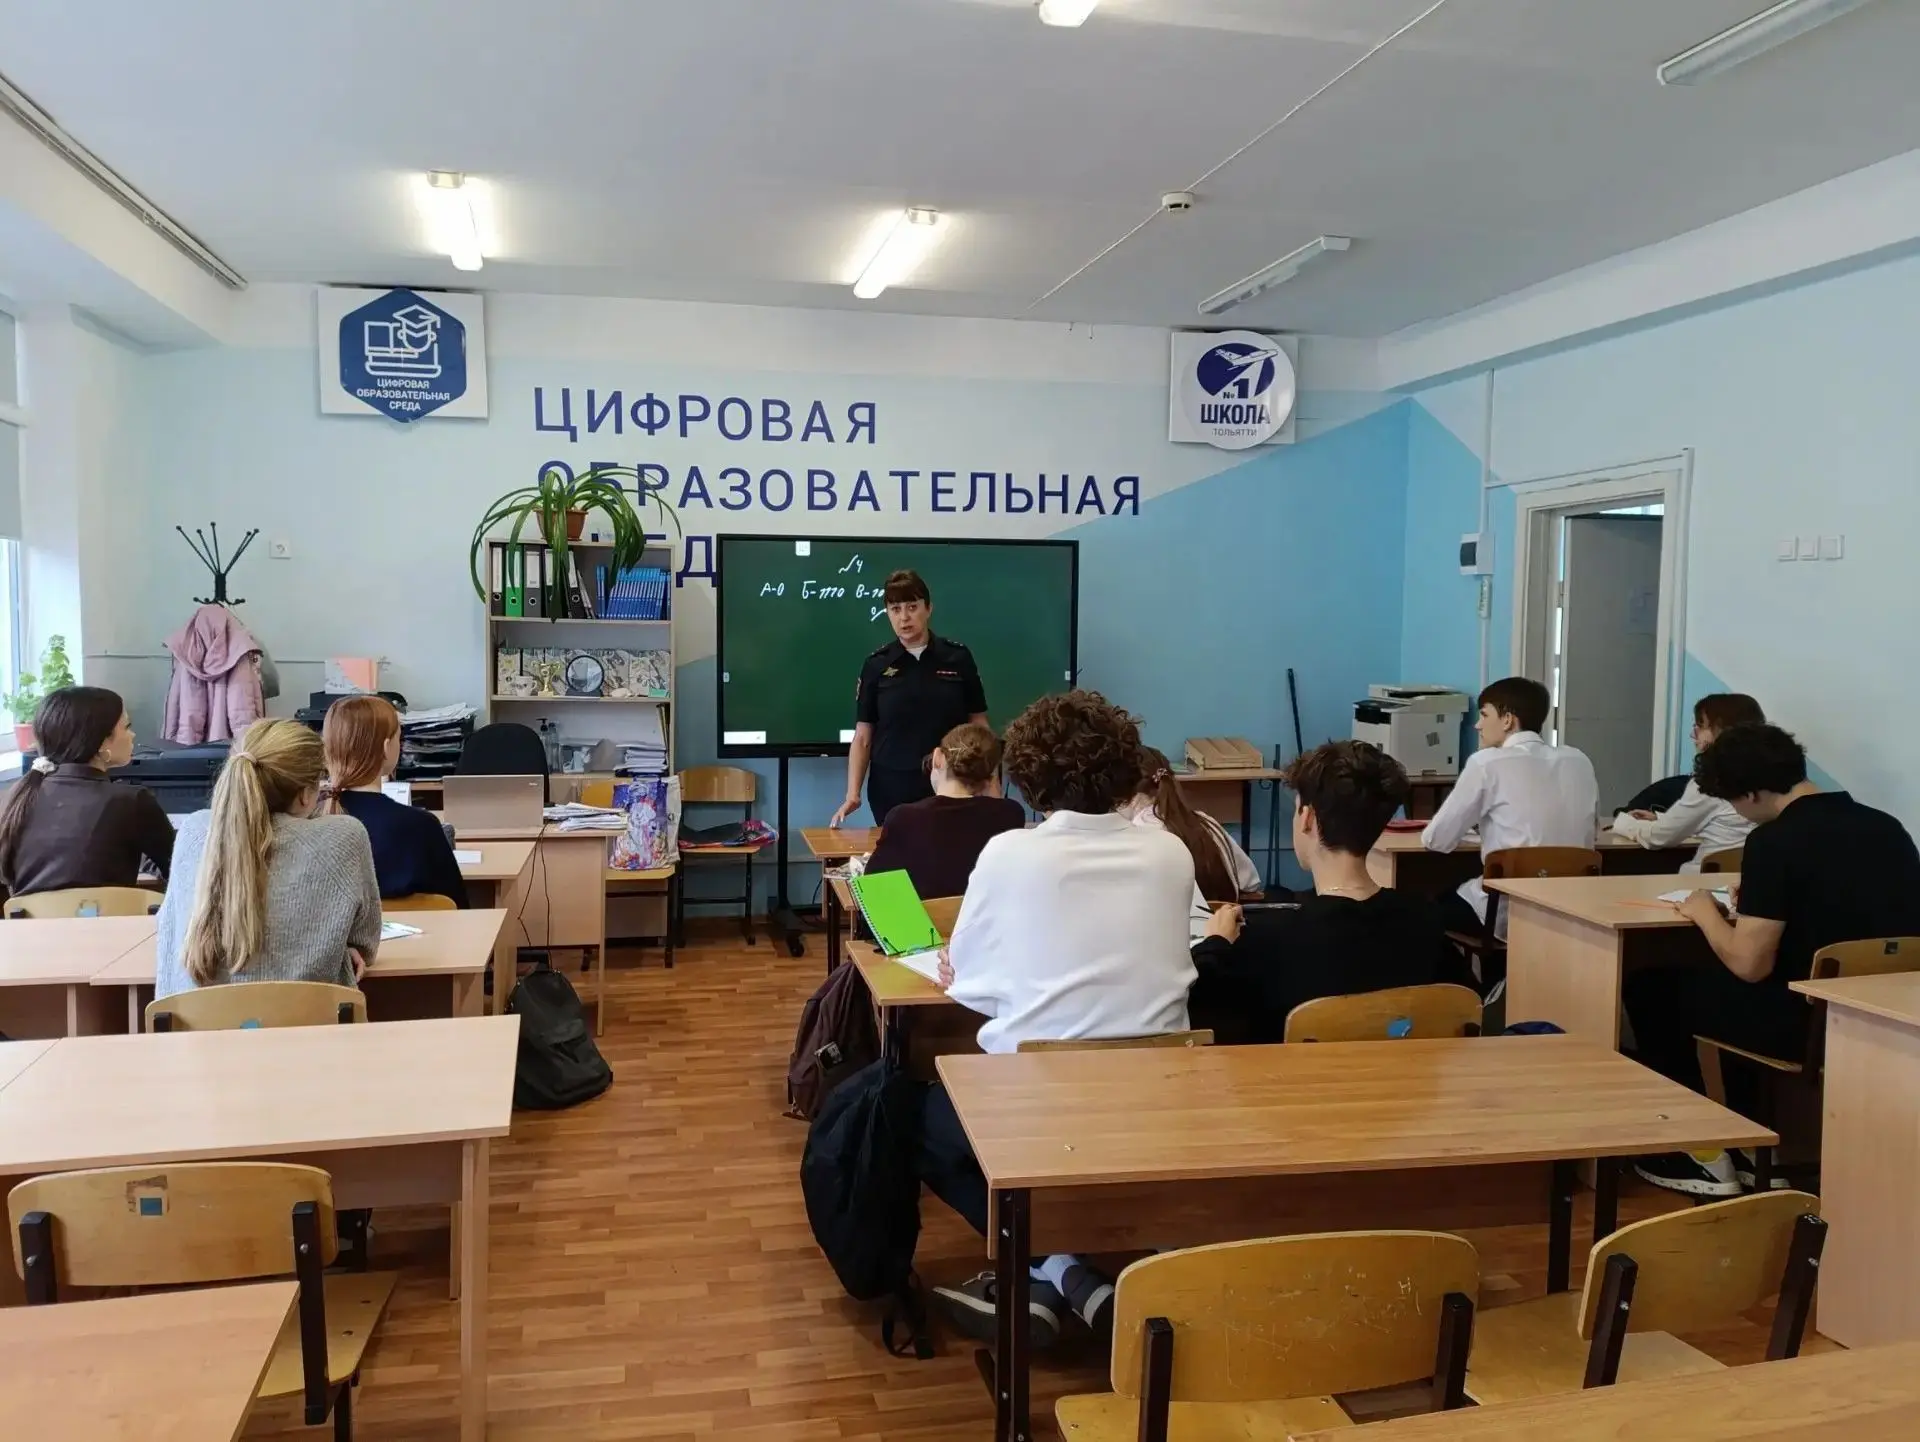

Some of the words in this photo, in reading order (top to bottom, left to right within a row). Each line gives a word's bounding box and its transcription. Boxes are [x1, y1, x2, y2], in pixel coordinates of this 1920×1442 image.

[377, 378, 430, 389] ЦИФРОВАЯ
[356, 388, 450, 401] ОБРАЗОВАТЕЛЬНАЯ
[389, 401, 421, 411] СРЕДА
[534, 387, 876, 444] ЦИФРОВАЯ
[1200, 404, 1270, 424] ШКОЛА
[1212, 428, 1257, 436] ТОЛЬЯТТИ
